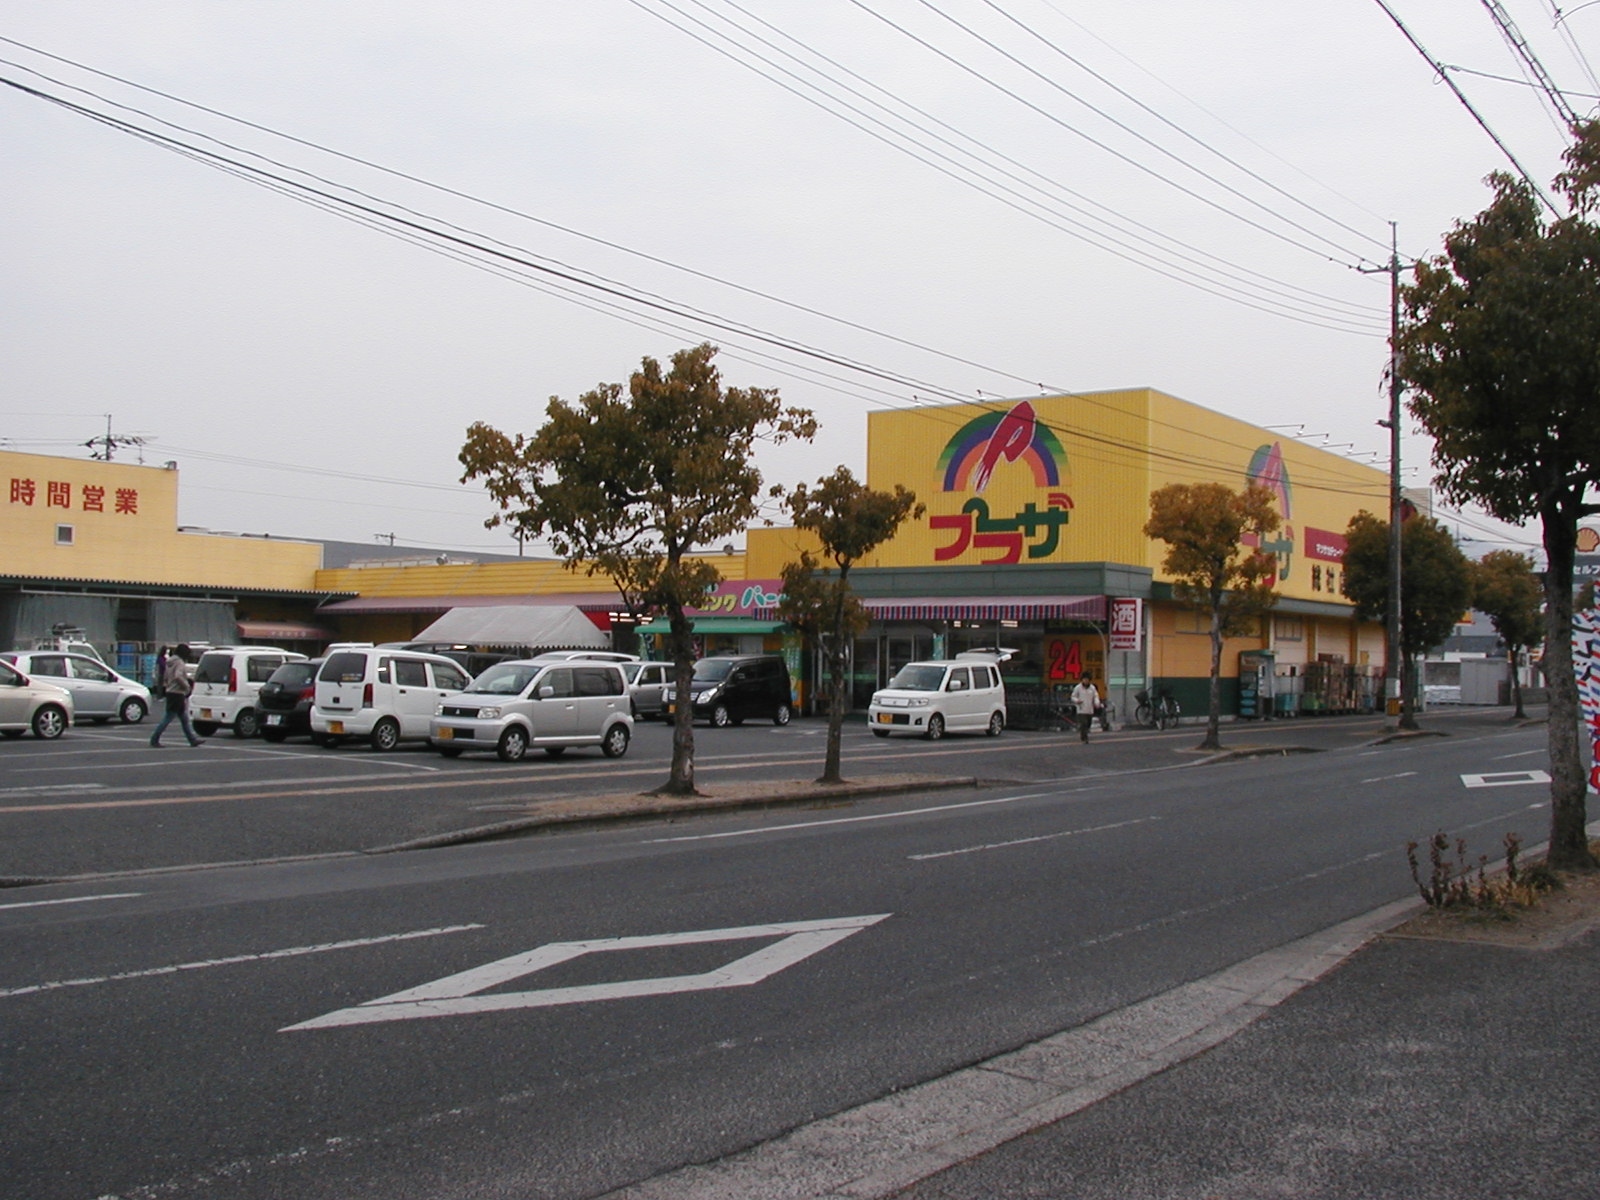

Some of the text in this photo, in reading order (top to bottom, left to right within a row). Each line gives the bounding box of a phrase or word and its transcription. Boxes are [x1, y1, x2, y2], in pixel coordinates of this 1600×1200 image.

[9, 477, 139, 516] 時間営業
[929, 492, 1075, 566] プラザ
[1112, 602, 1136, 632] 酒
[1049, 639, 1082, 680] 24
